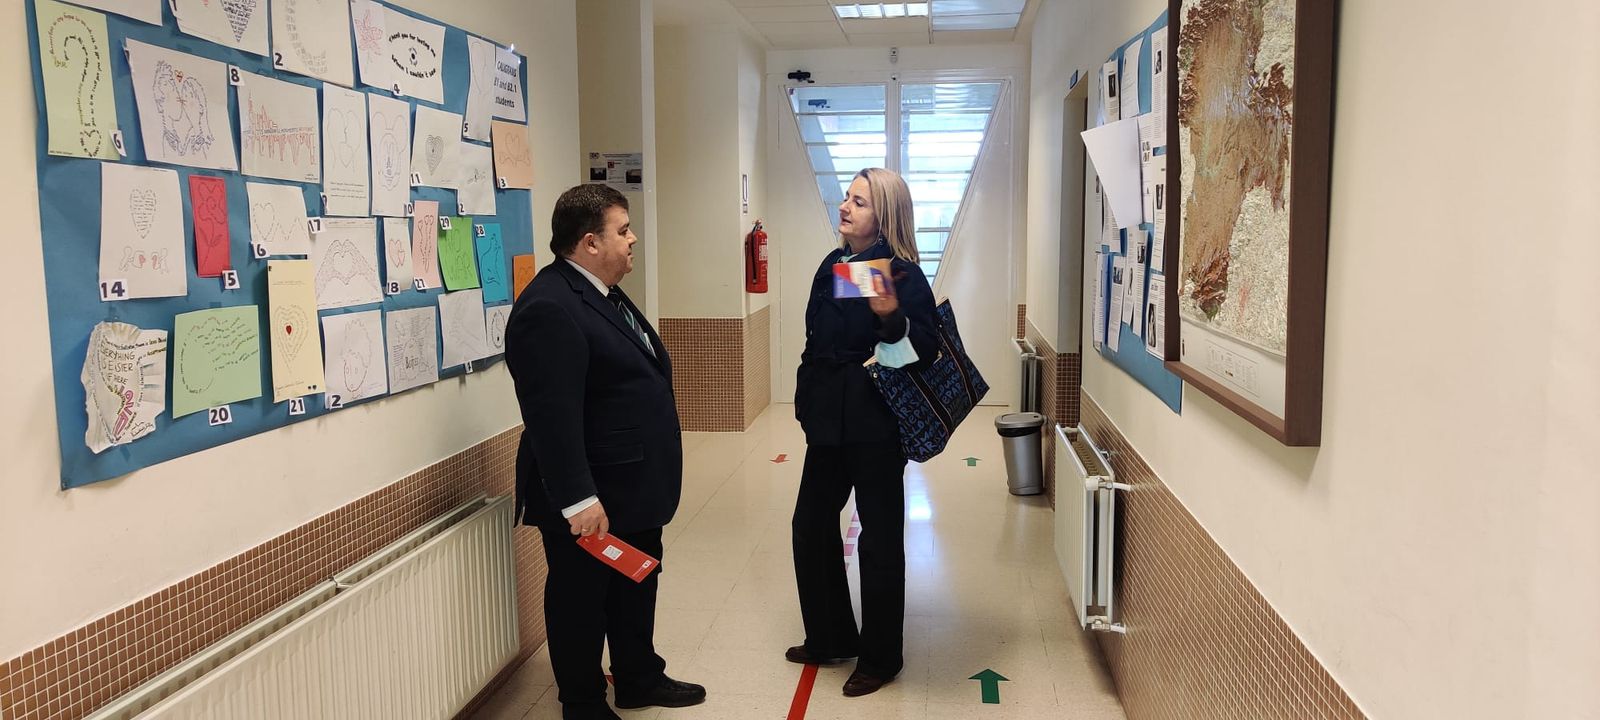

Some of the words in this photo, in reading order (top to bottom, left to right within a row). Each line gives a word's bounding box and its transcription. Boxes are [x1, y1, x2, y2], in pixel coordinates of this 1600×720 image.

[274, 52, 283, 66] 2
[230, 68, 239, 82] 8
[394, 84, 400, 94] 4
[495, 96, 515, 108] students
[114, 133, 121, 149] 6
[411, 173, 420, 184] 11
[308, 219, 321, 231] 17
[440, 218, 450, 228] 29
[101, 281, 125, 298] 14
[290, 399, 304, 412] 21
[210, 409, 229, 423] 20
